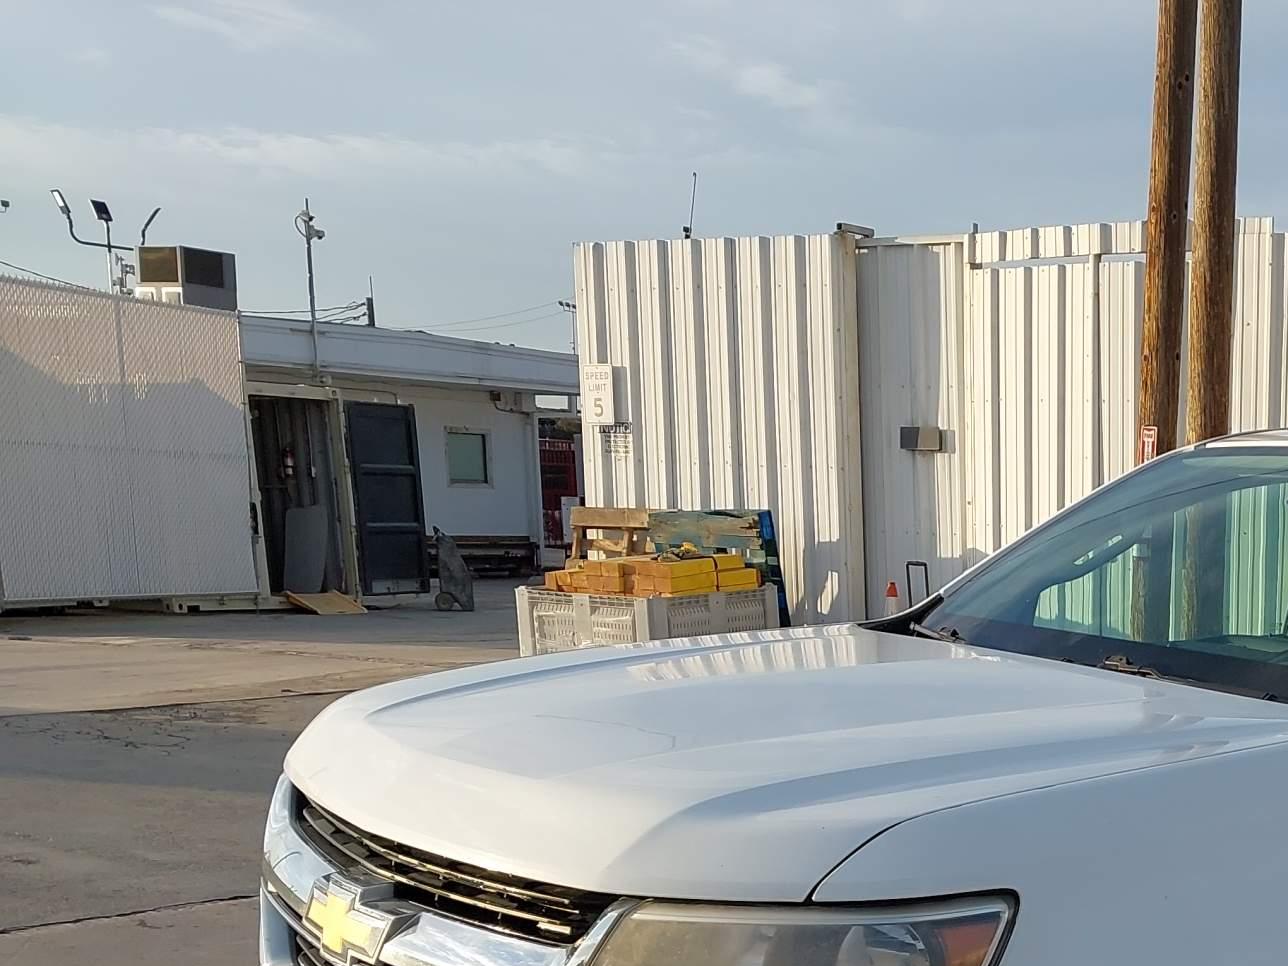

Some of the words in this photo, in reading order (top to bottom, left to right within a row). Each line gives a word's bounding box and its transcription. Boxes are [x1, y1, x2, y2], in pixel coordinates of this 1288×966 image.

[585, 371, 609, 381] SPEED
[588, 383, 608, 392] LIMIT
[593, 397, 604, 418] 5
